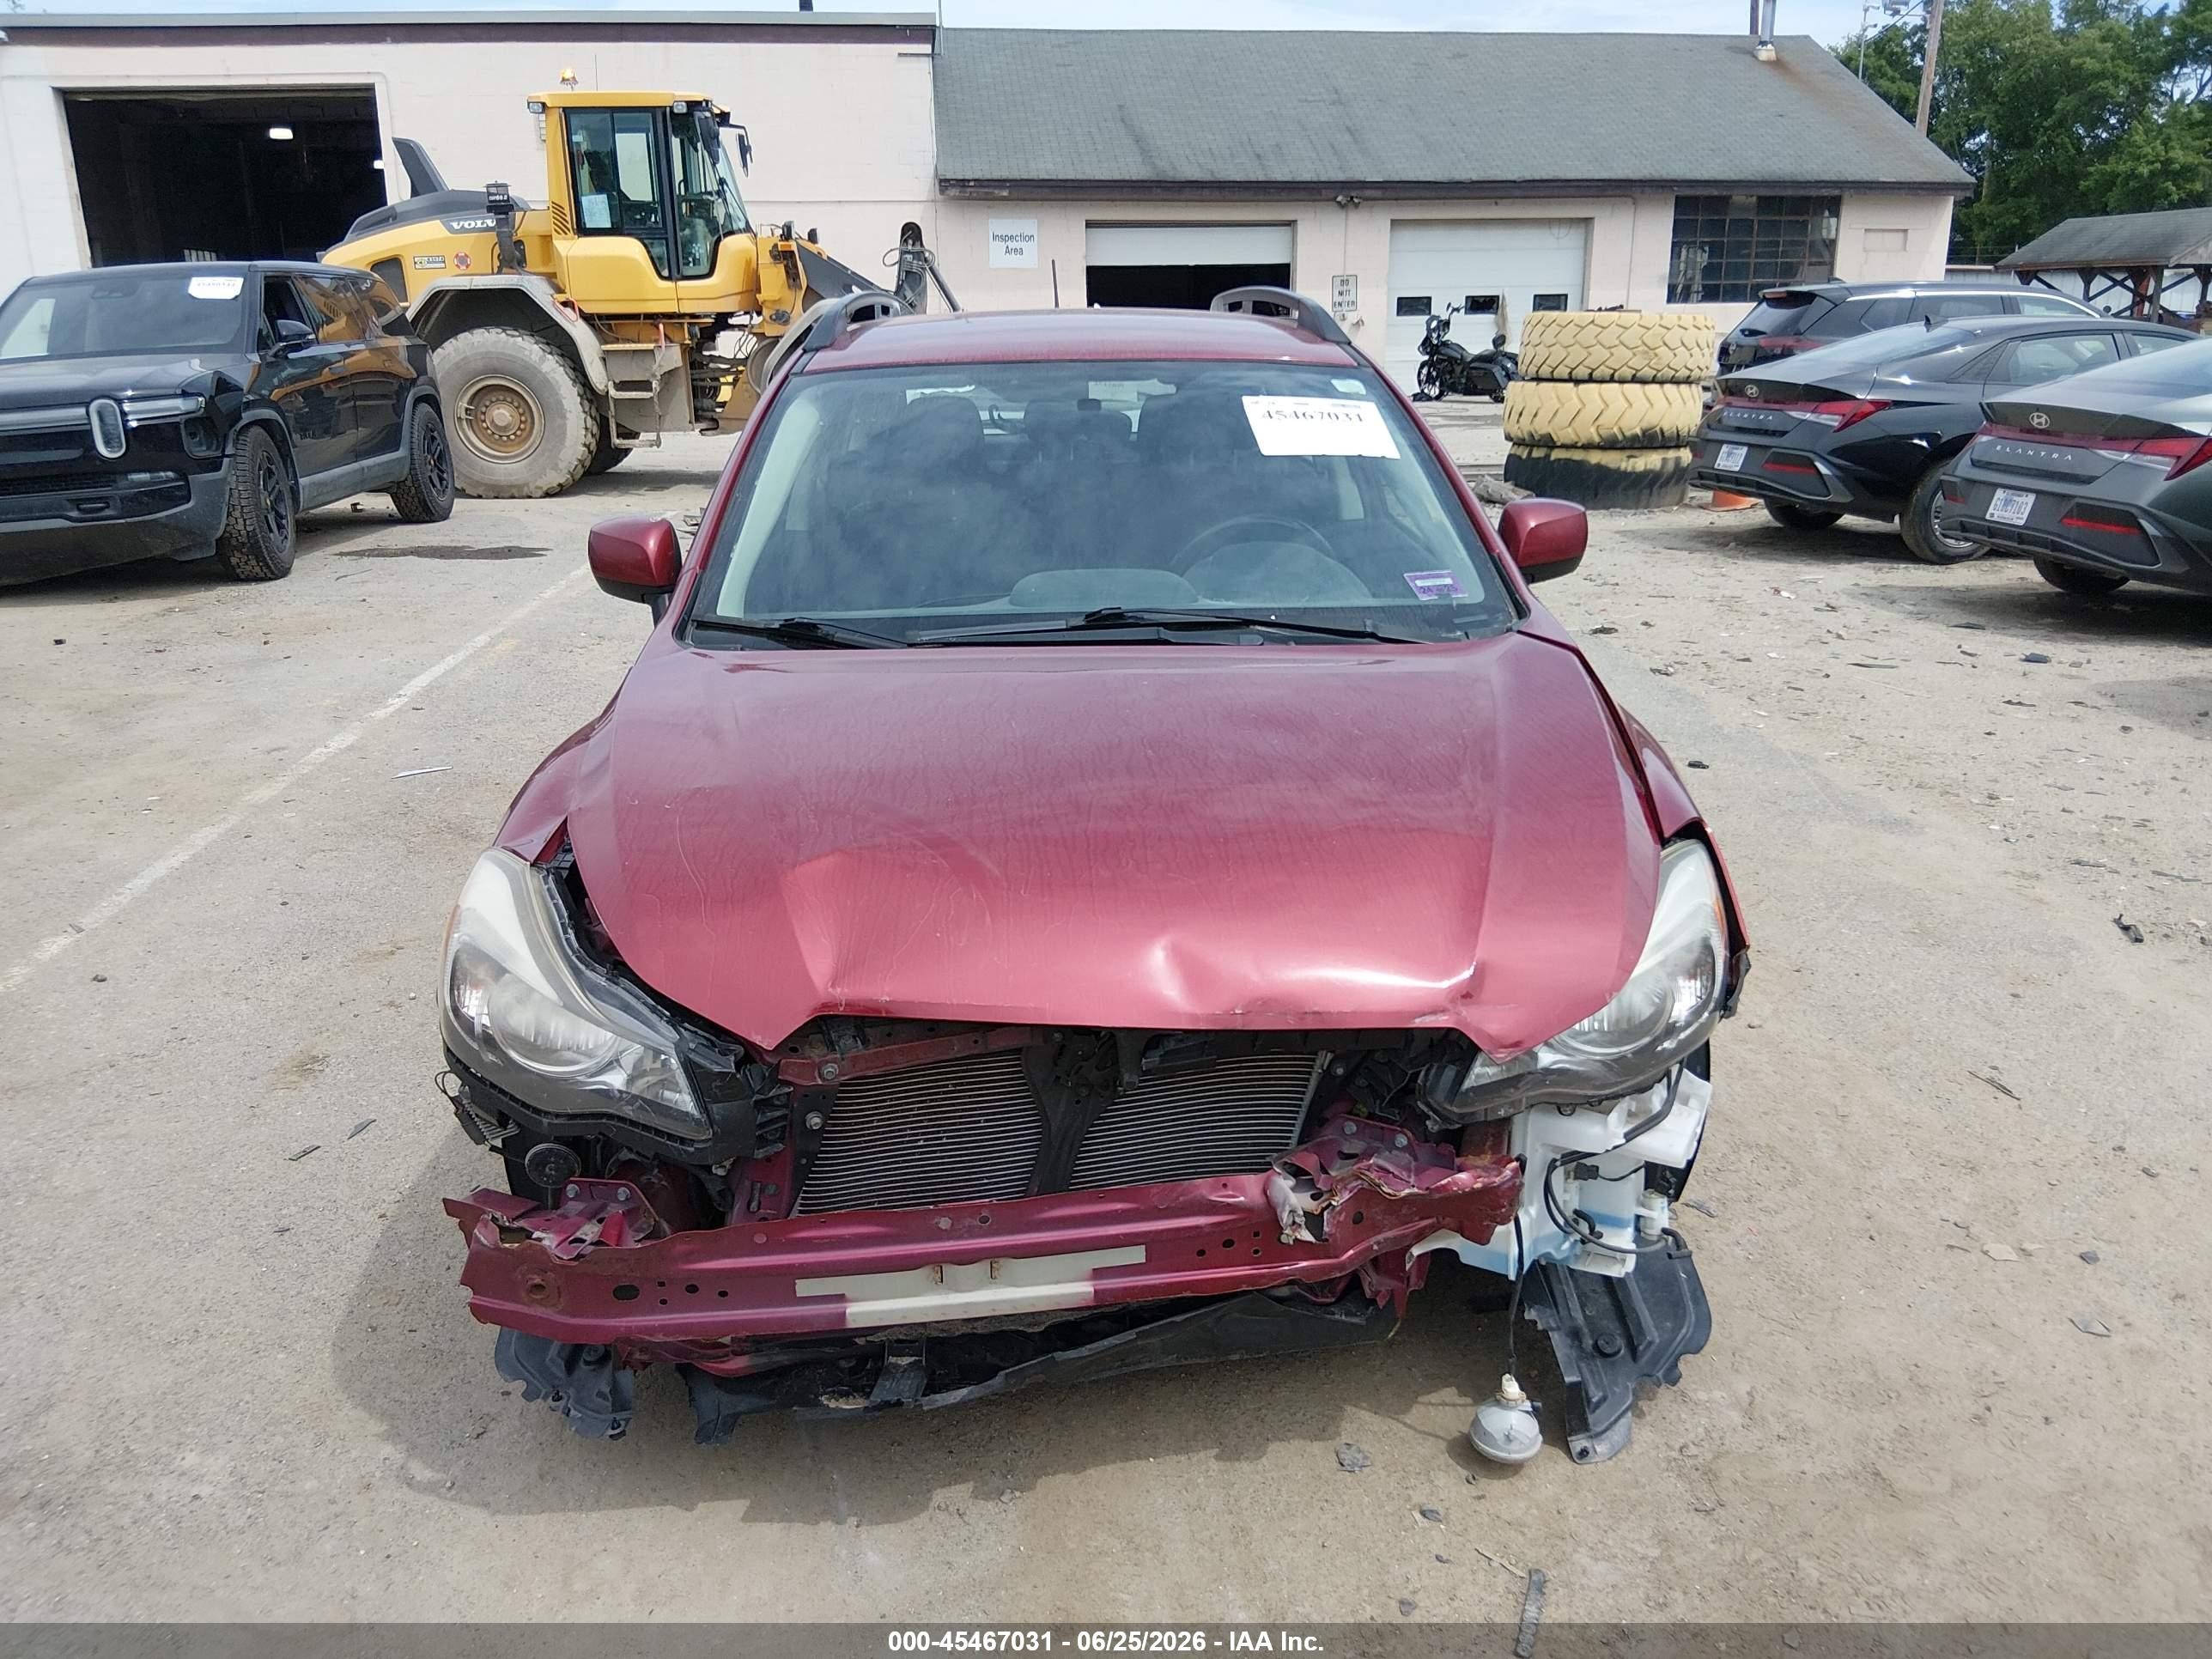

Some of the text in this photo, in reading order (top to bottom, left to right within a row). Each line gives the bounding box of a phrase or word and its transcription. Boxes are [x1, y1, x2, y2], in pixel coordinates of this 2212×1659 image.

[451, 219, 496, 229] VOLV
[992, 231, 1035, 245] Inspection
[1004, 244, 1024, 256] Area
[1340, 278, 1350, 287] DO
[1334, 301, 1356, 309] ENTER
[1262, 410, 1364, 422] 45467031
[1996, 445, 2072, 461] ELANTRA
